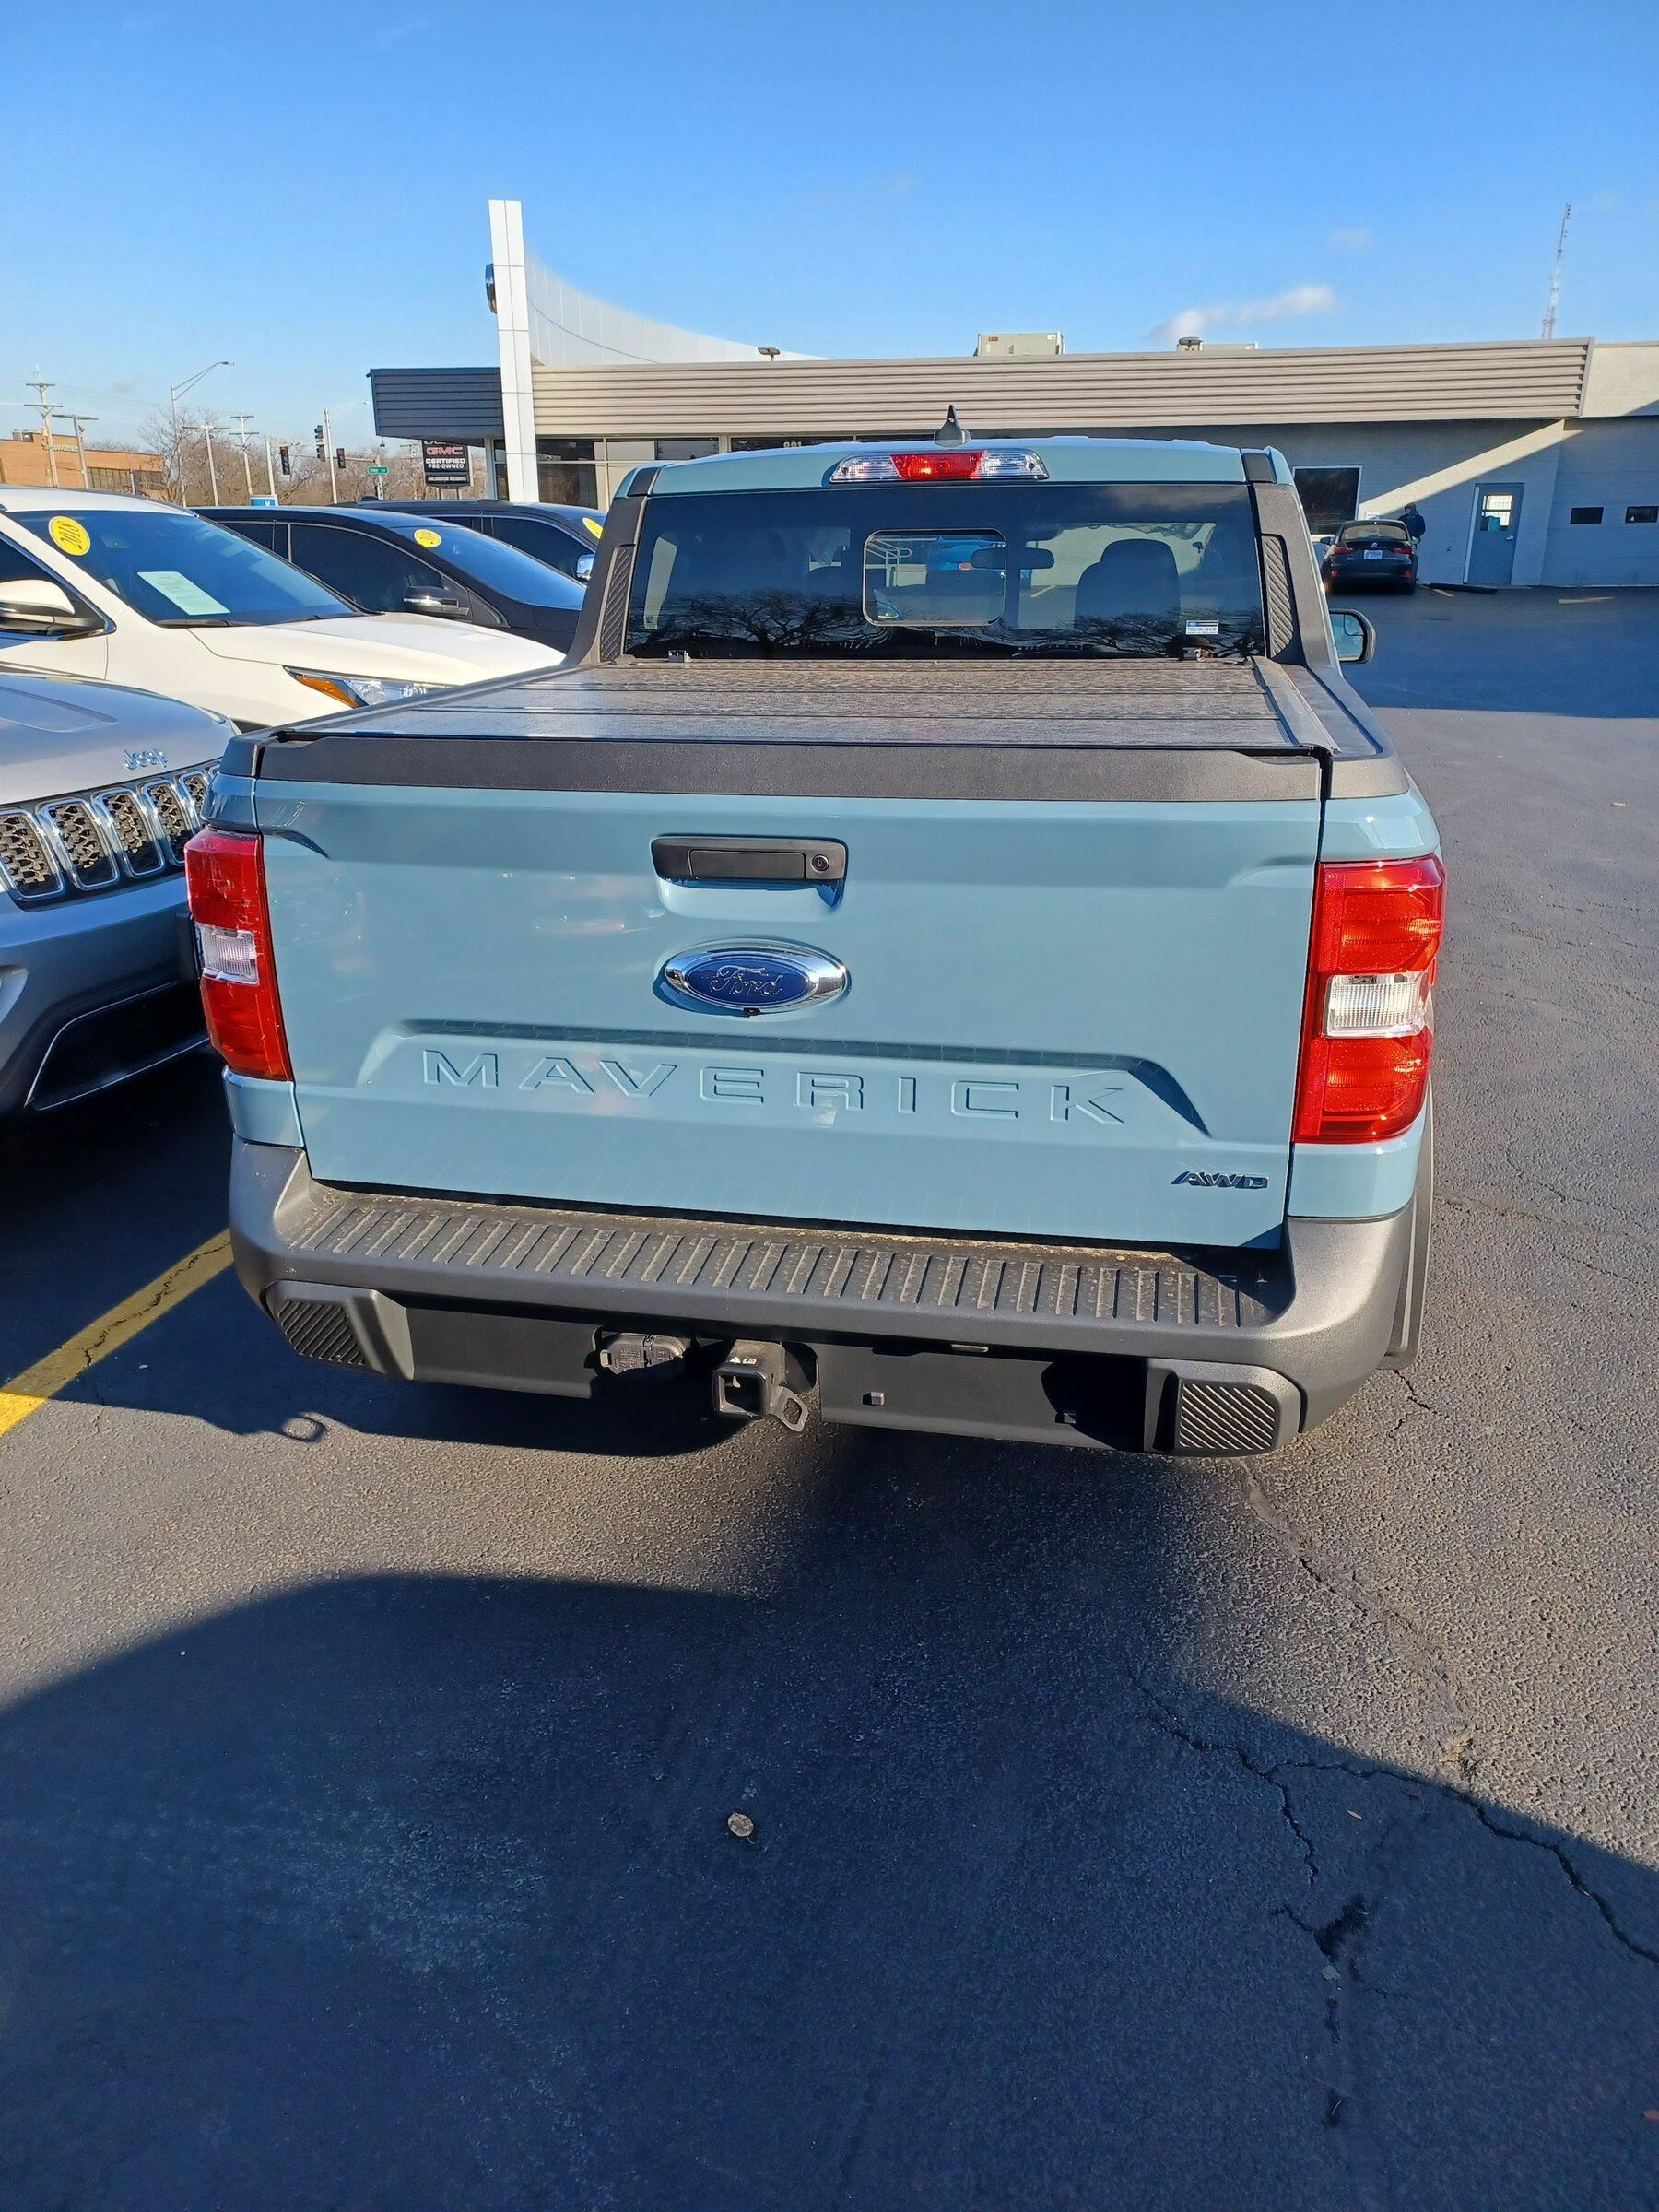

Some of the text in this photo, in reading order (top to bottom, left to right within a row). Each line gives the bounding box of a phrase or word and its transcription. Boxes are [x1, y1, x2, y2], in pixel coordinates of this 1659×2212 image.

[426, 446, 464, 455] GMC
[118, 747, 170, 771] Jeep
[710, 964, 784, 997] Ford
[421, 1048, 1126, 1125] MAVERICK
[1173, 1171, 1269, 1189] AWD
